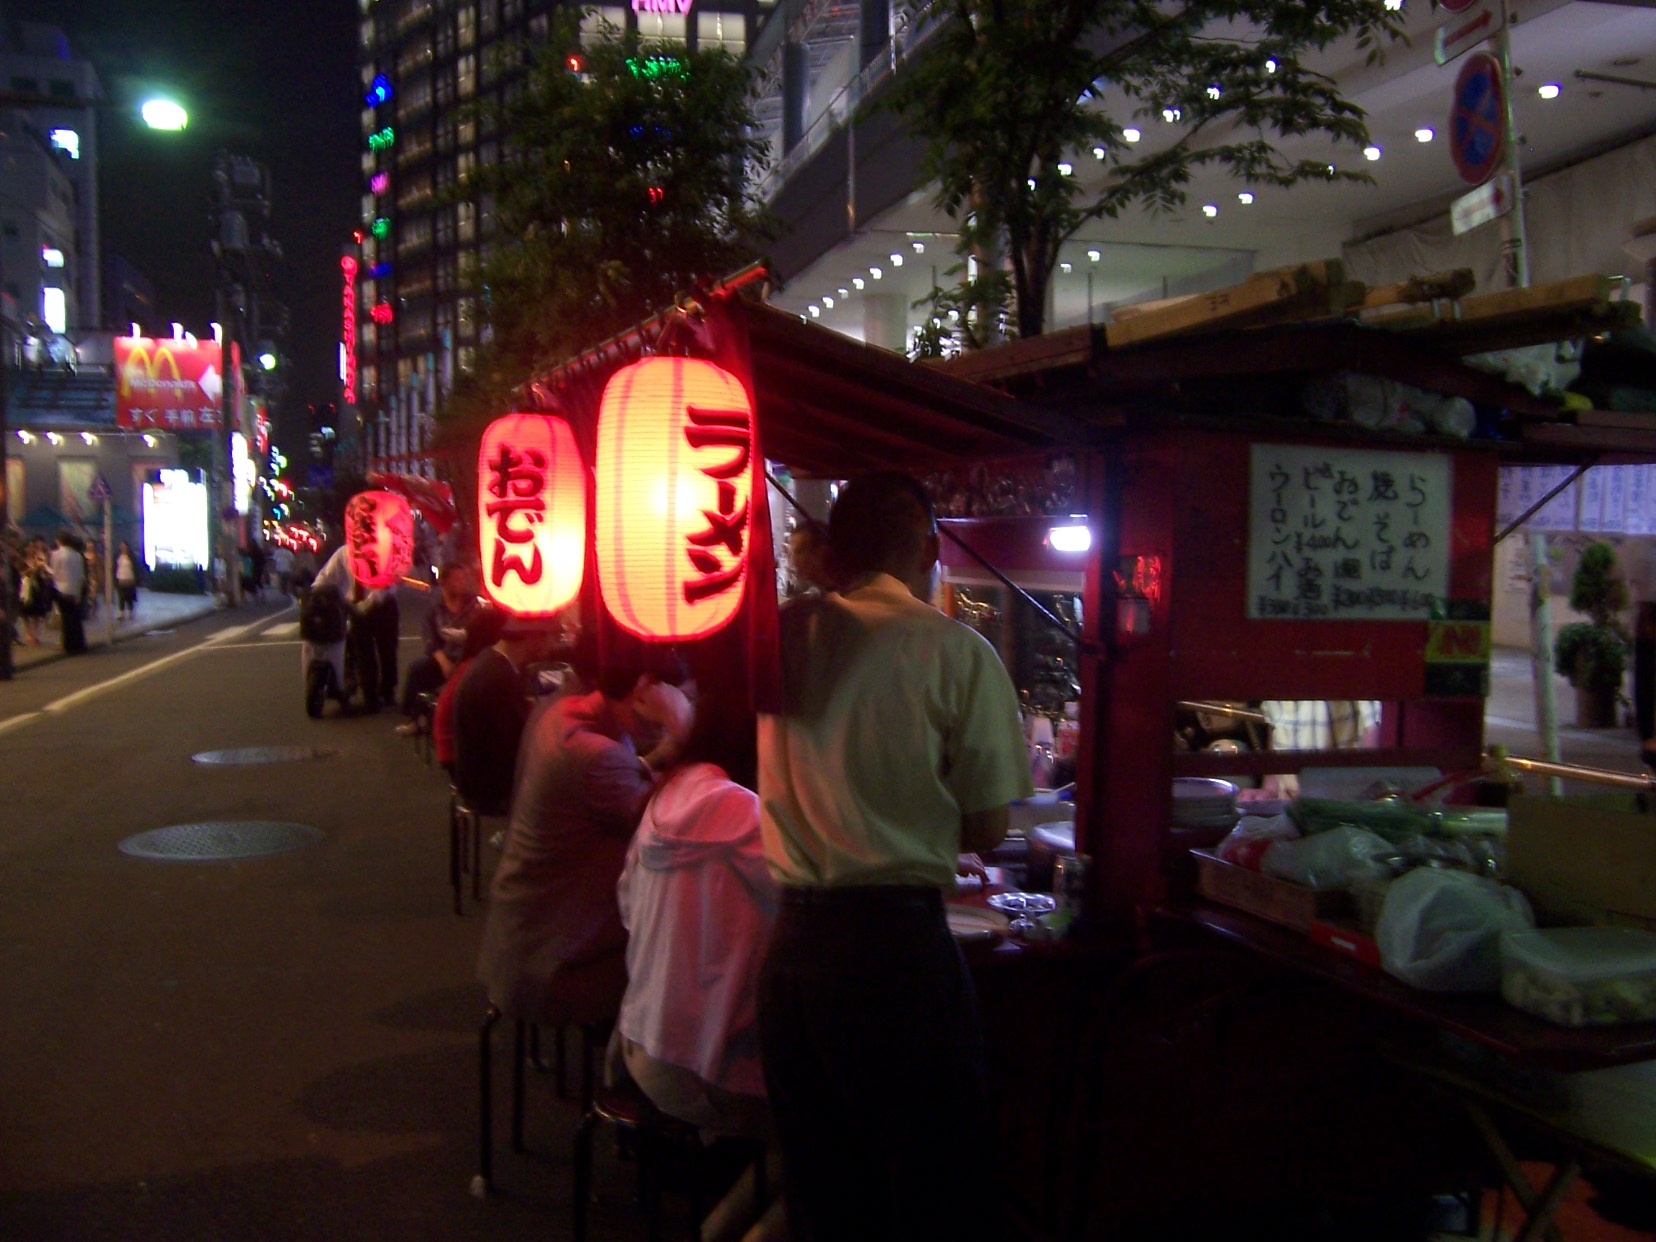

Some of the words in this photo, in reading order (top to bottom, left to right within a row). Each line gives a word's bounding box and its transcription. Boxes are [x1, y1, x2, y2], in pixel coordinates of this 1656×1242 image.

[631, 0, 693, 14] HMV
[485, 441, 546, 588] おでん
[682, 403, 752, 606] ラーメン
[1265, 463, 1294, 592] ウーロンハイ
[1404, 473, 1431, 581] らーめん
